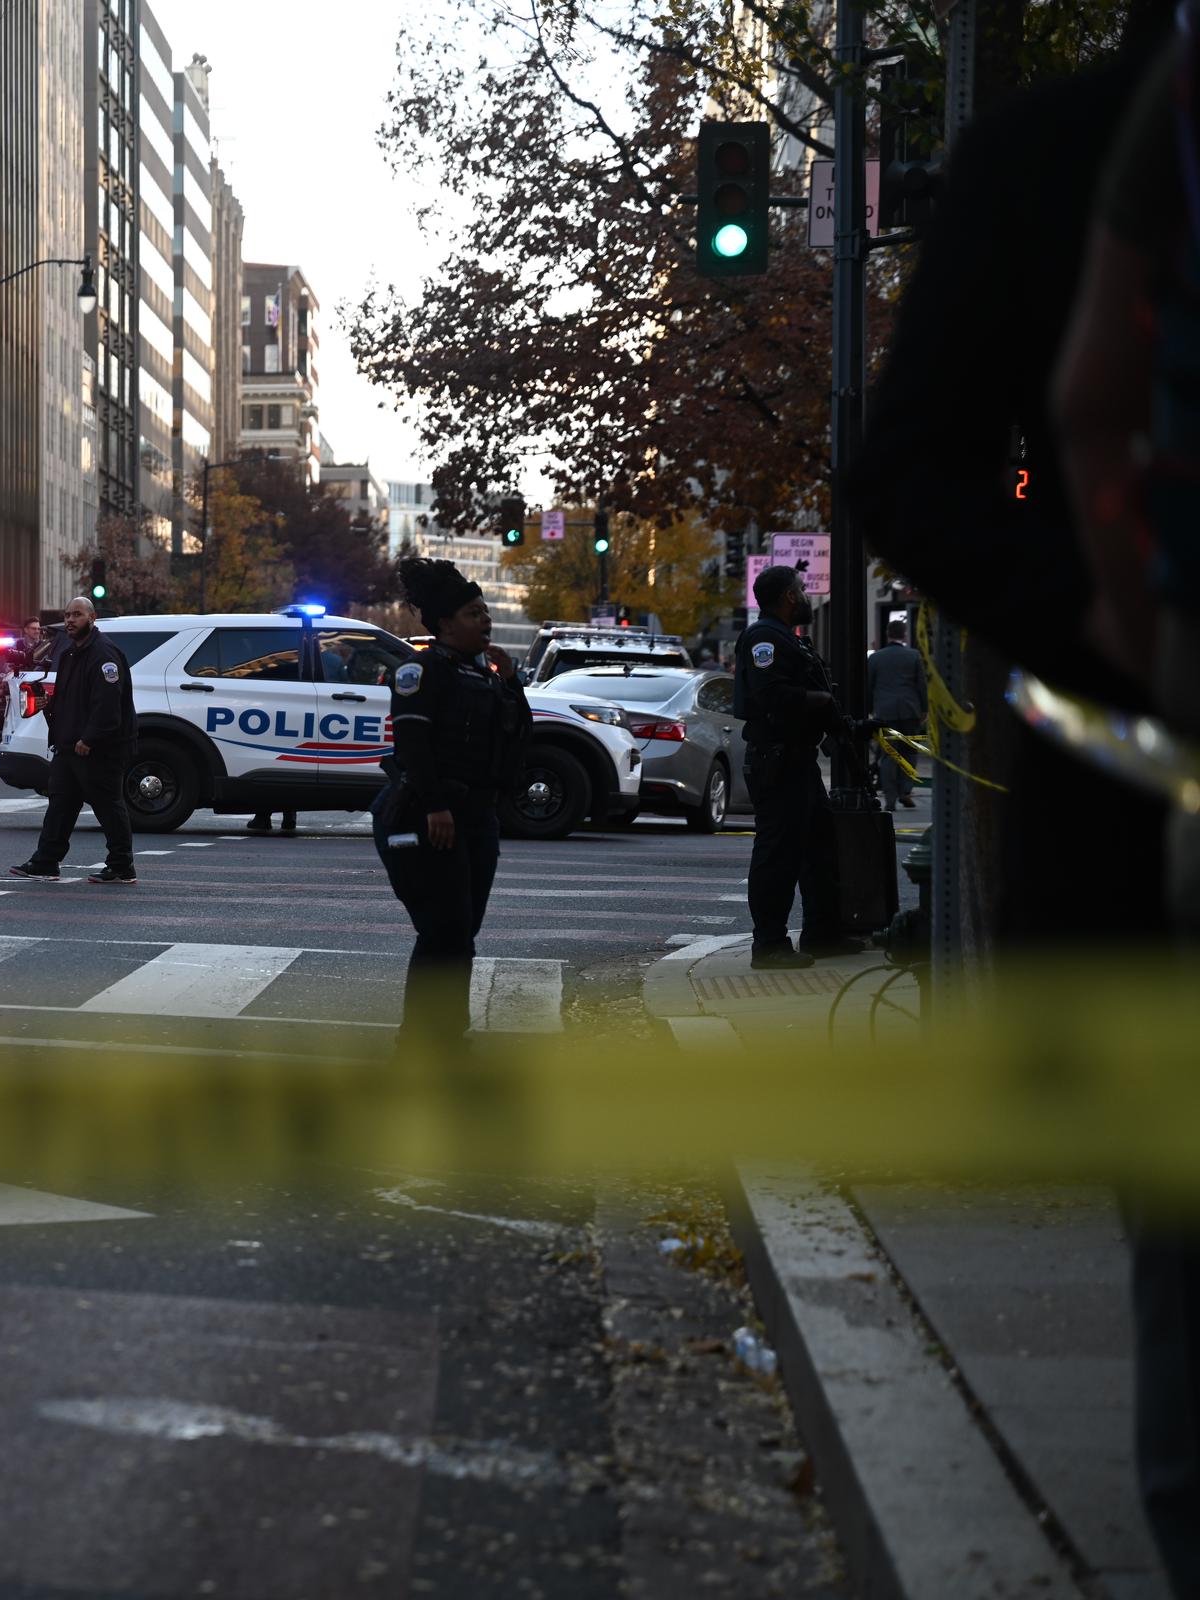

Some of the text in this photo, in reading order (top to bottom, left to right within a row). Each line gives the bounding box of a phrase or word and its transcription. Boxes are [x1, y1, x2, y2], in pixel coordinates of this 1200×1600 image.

[1016, 469, 1028, 498] 2
[790, 538, 814, 547] BEGIN
[774, 549, 829, 557] RIGHT TURN LANE
[807, 573, 829, 581] BUSES
[206, 706, 382, 742] POLICE
